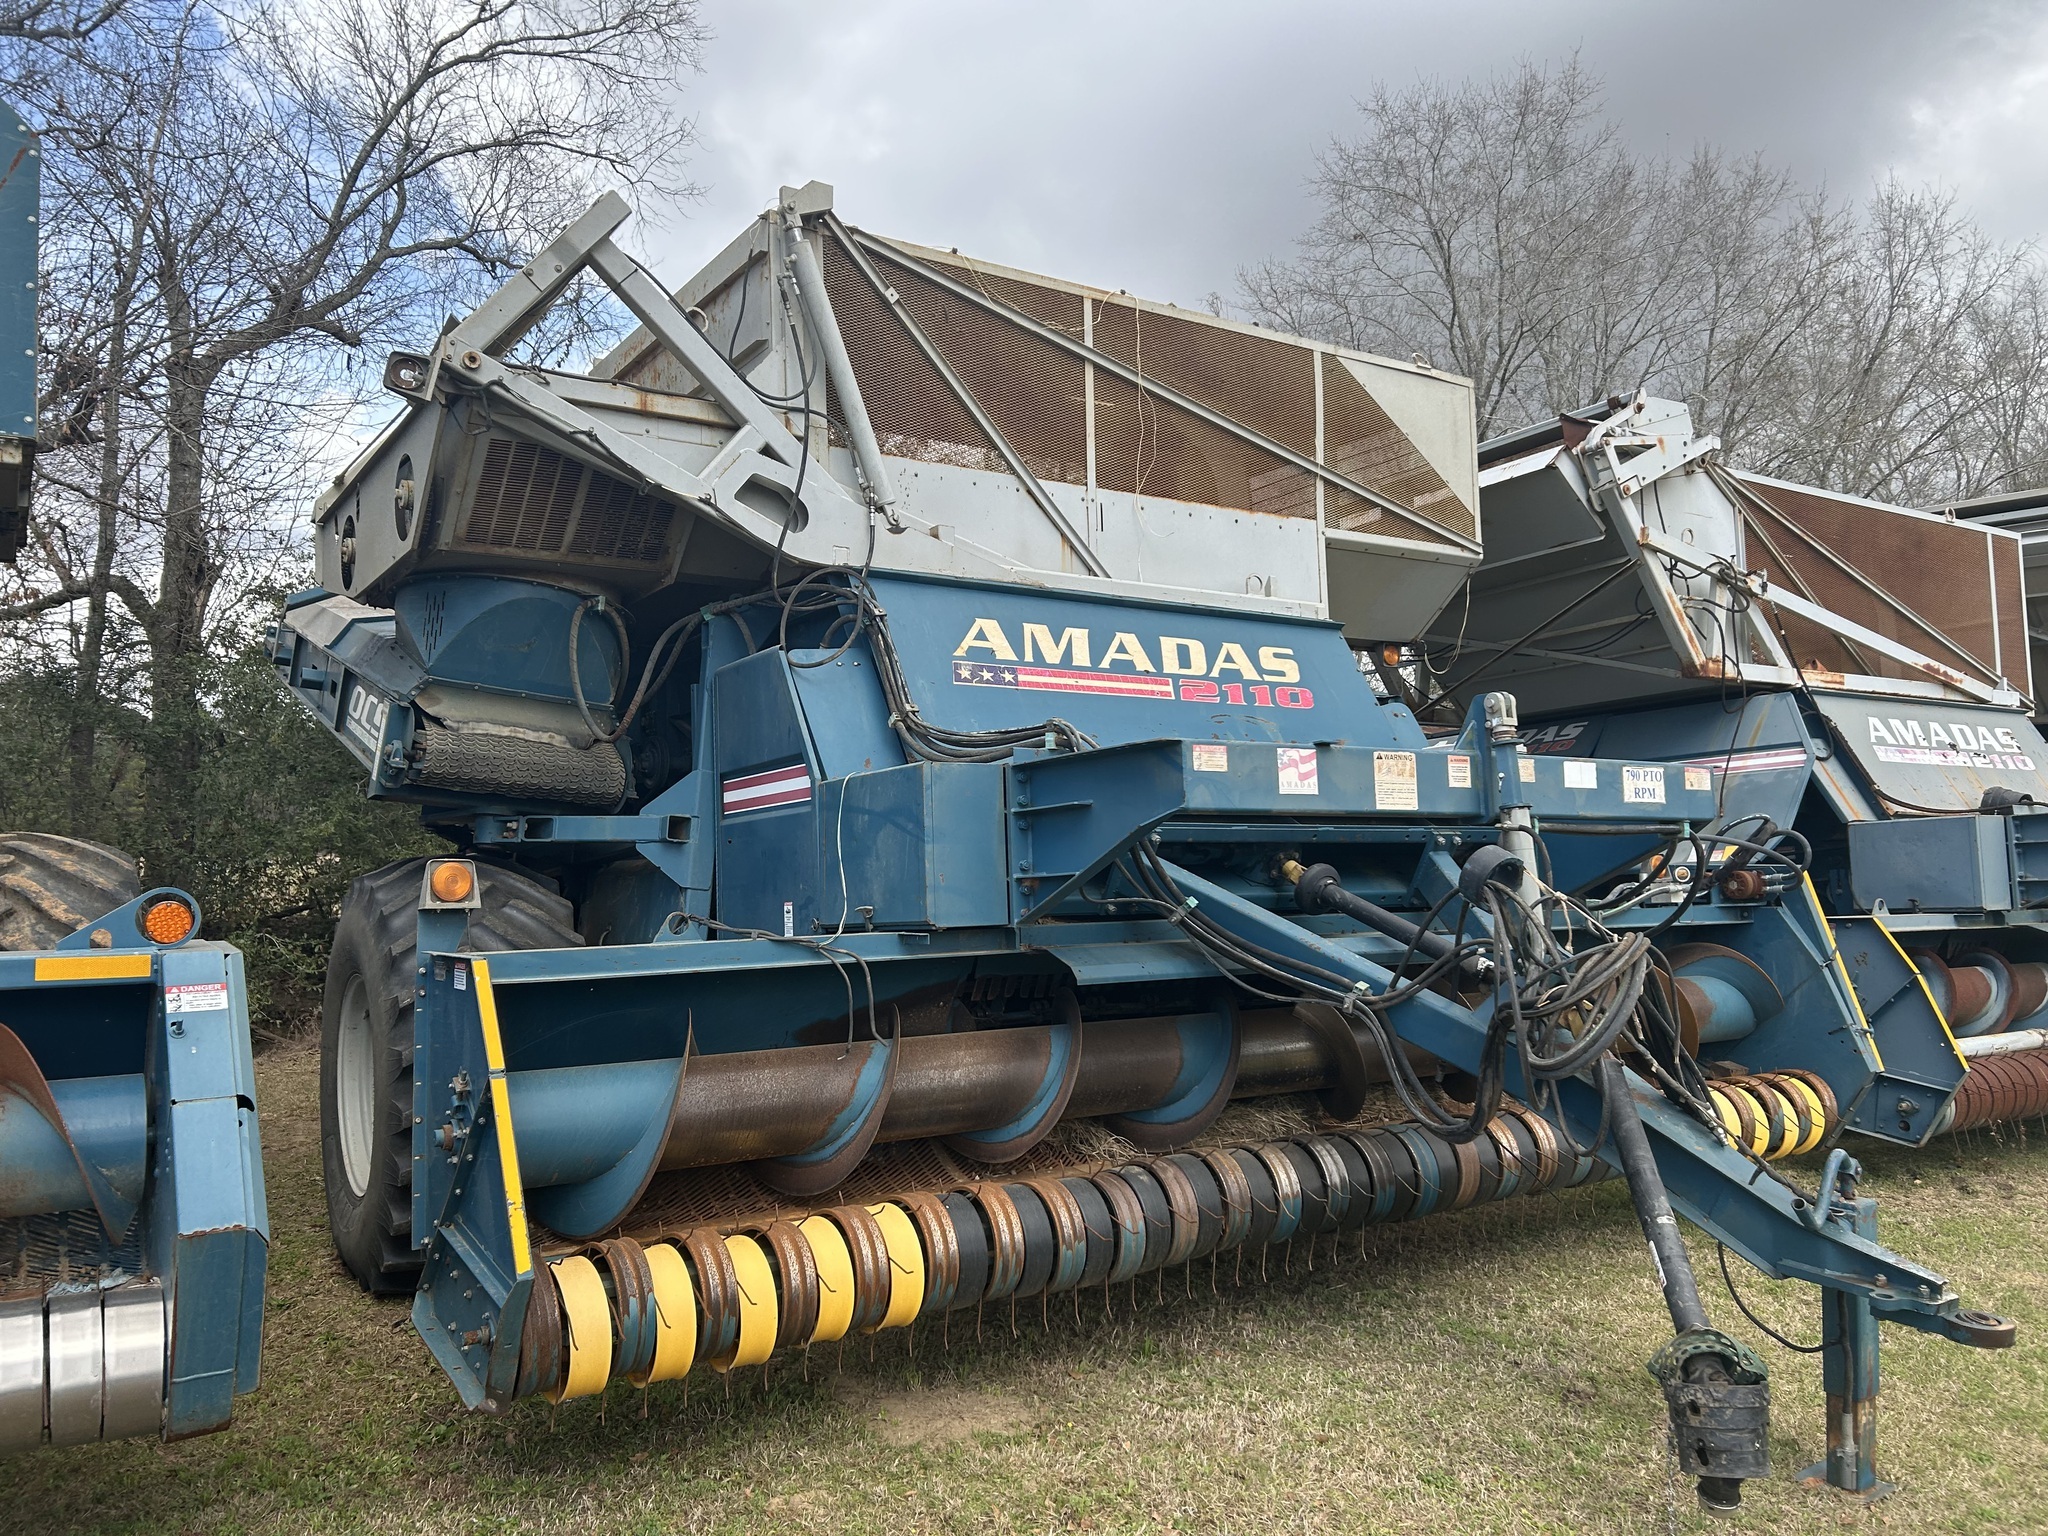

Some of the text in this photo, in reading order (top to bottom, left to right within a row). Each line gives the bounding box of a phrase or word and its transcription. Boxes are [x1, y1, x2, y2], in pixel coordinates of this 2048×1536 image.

[953, 617, 1300, 683] AMADAS
[1179, 678, 1314, 709] 2110
[1867, 716, 2023, 754] AMADAS
[1643, 770, 1663, 782] PTO
[1634, 787, 1656, 799] RPM
[180, 983, 222, 992] DANGER
